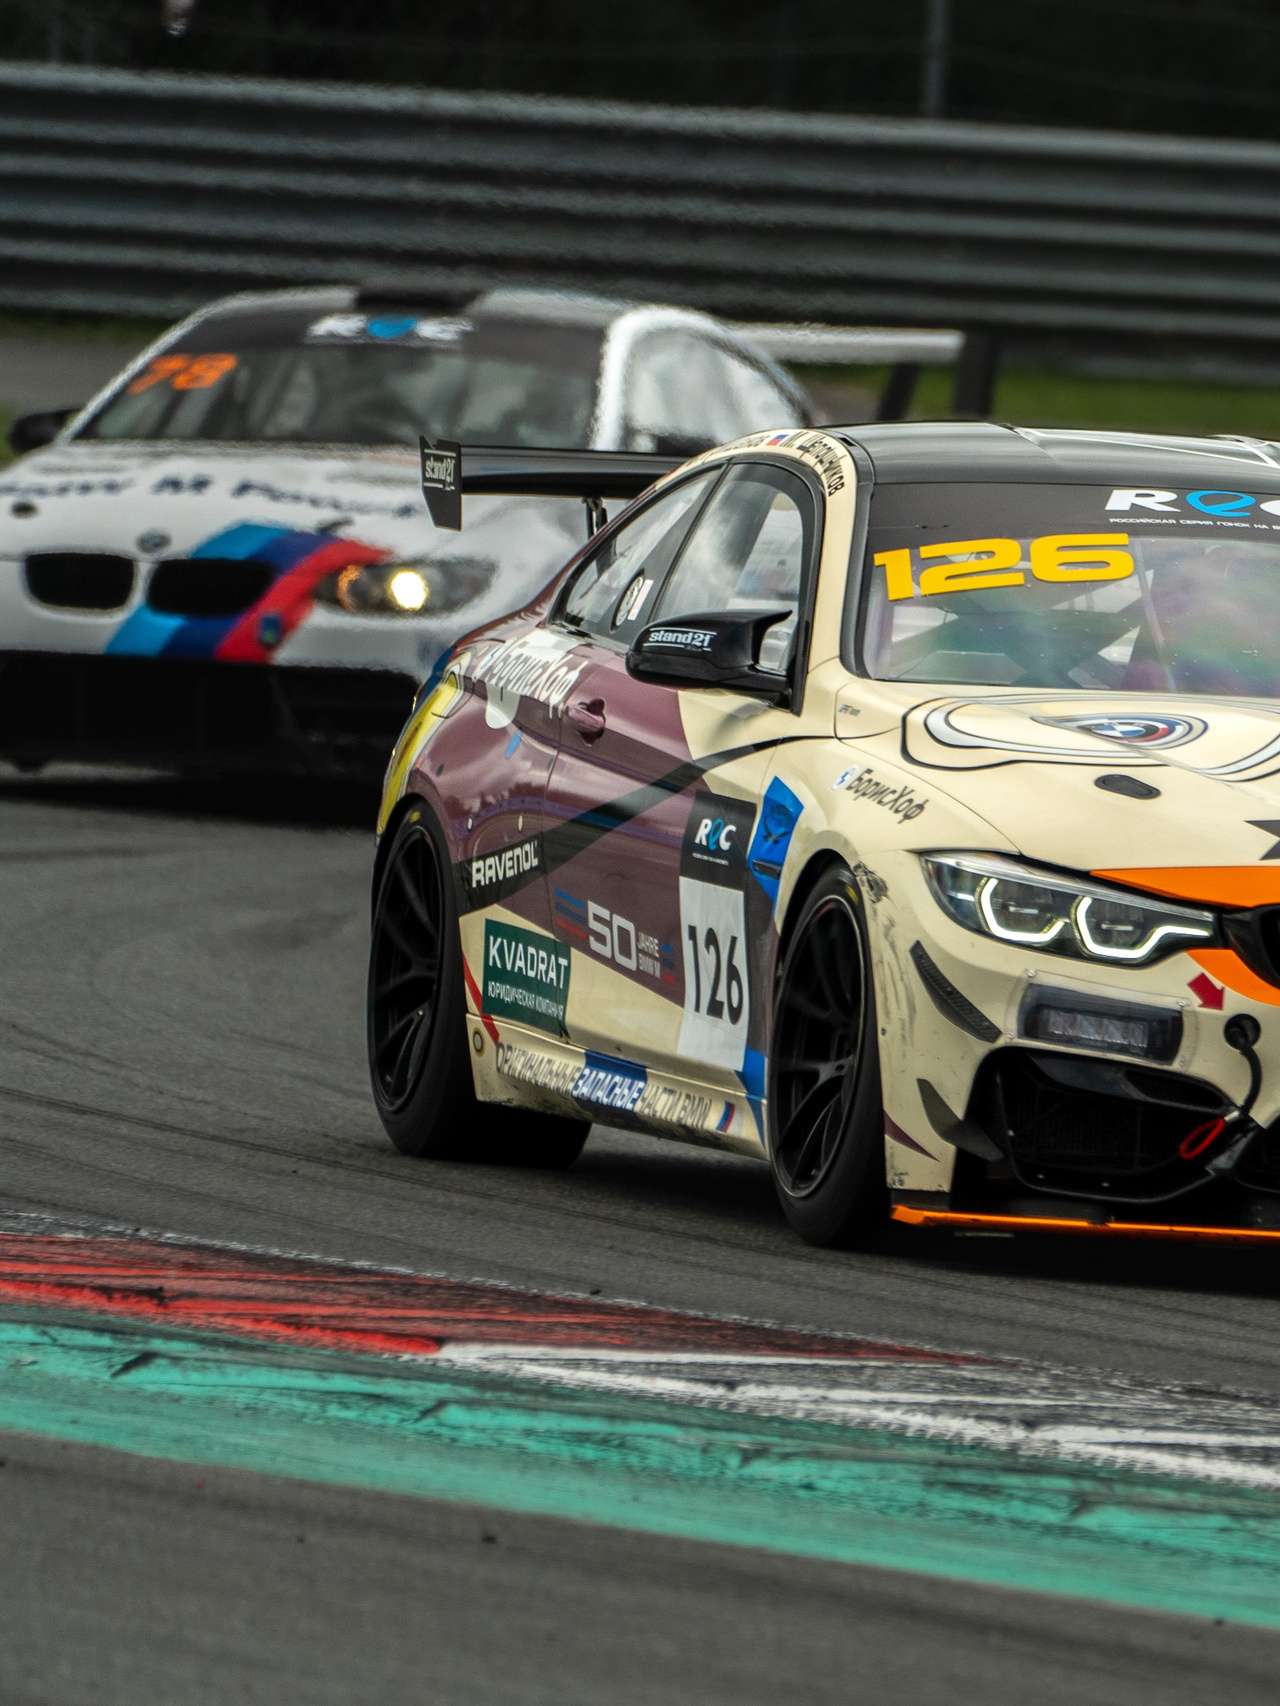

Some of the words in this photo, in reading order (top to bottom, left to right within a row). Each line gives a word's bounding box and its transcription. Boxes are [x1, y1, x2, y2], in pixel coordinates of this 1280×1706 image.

[1109, 517, 1176, 525] РОССИЙСКАЯ
[1217, 521, 1250, 529] ГОНОК
[873, 533, 1135, 601] 126
[648, 630, 714, 648] stand21
[845, 768, 930, 824] БорисХоф
[472, 842, 540, 888] RAVENOL
[488, 936, 569, 989] KVADRAT
[587, 900, 637, 971] 50
[488, 981, 535, 1010] ЮРИДИЧЕСКАЯ
[687, 925, 744, 1026] 126
[496, 1042, 582, 1095] ОРИГИНАЛЬНЫЕ
[572, 1067, 646, 1111] ЗАПАСНЫЕ
